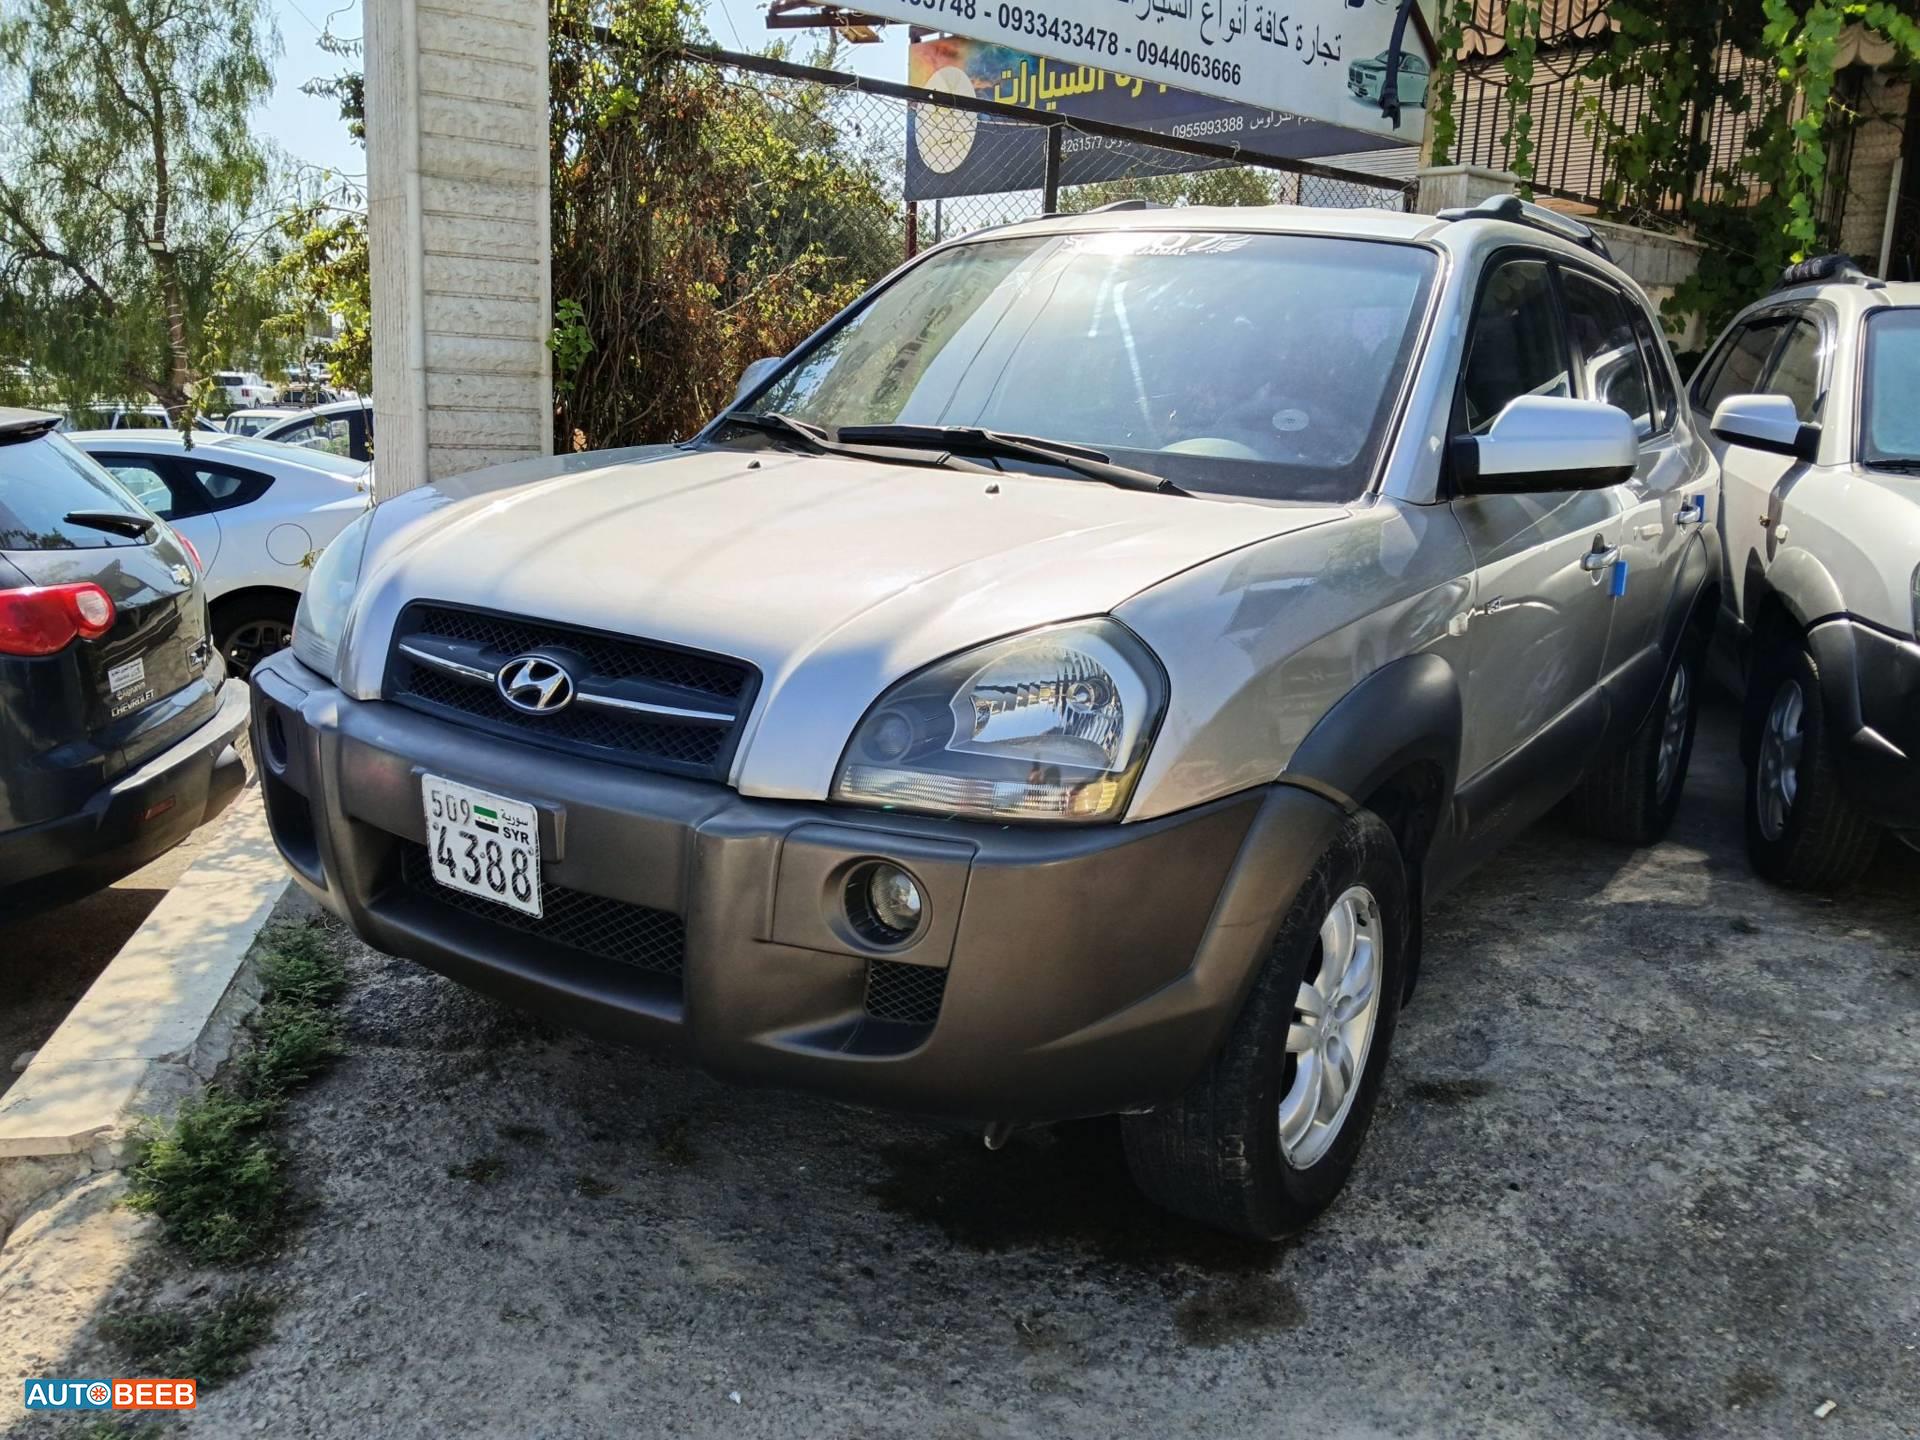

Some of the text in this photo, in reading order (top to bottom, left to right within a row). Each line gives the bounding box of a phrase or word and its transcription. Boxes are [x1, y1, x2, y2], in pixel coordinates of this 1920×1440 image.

[998, 3, 1119, 56] 0933433478
[1137, 40, 1241, 85] 0944063666
[1254, 6, 1289, 47] كافة
[1295, 24, 1342, 66] تجارة
[1172, 116, 1244, 138] 0955993388
[431, 789, 471, 825] 509
[501, 808, 529, 827] سورية
[503, 827, 530, 846] SYR
[437, 826, 532, 904] 4388
